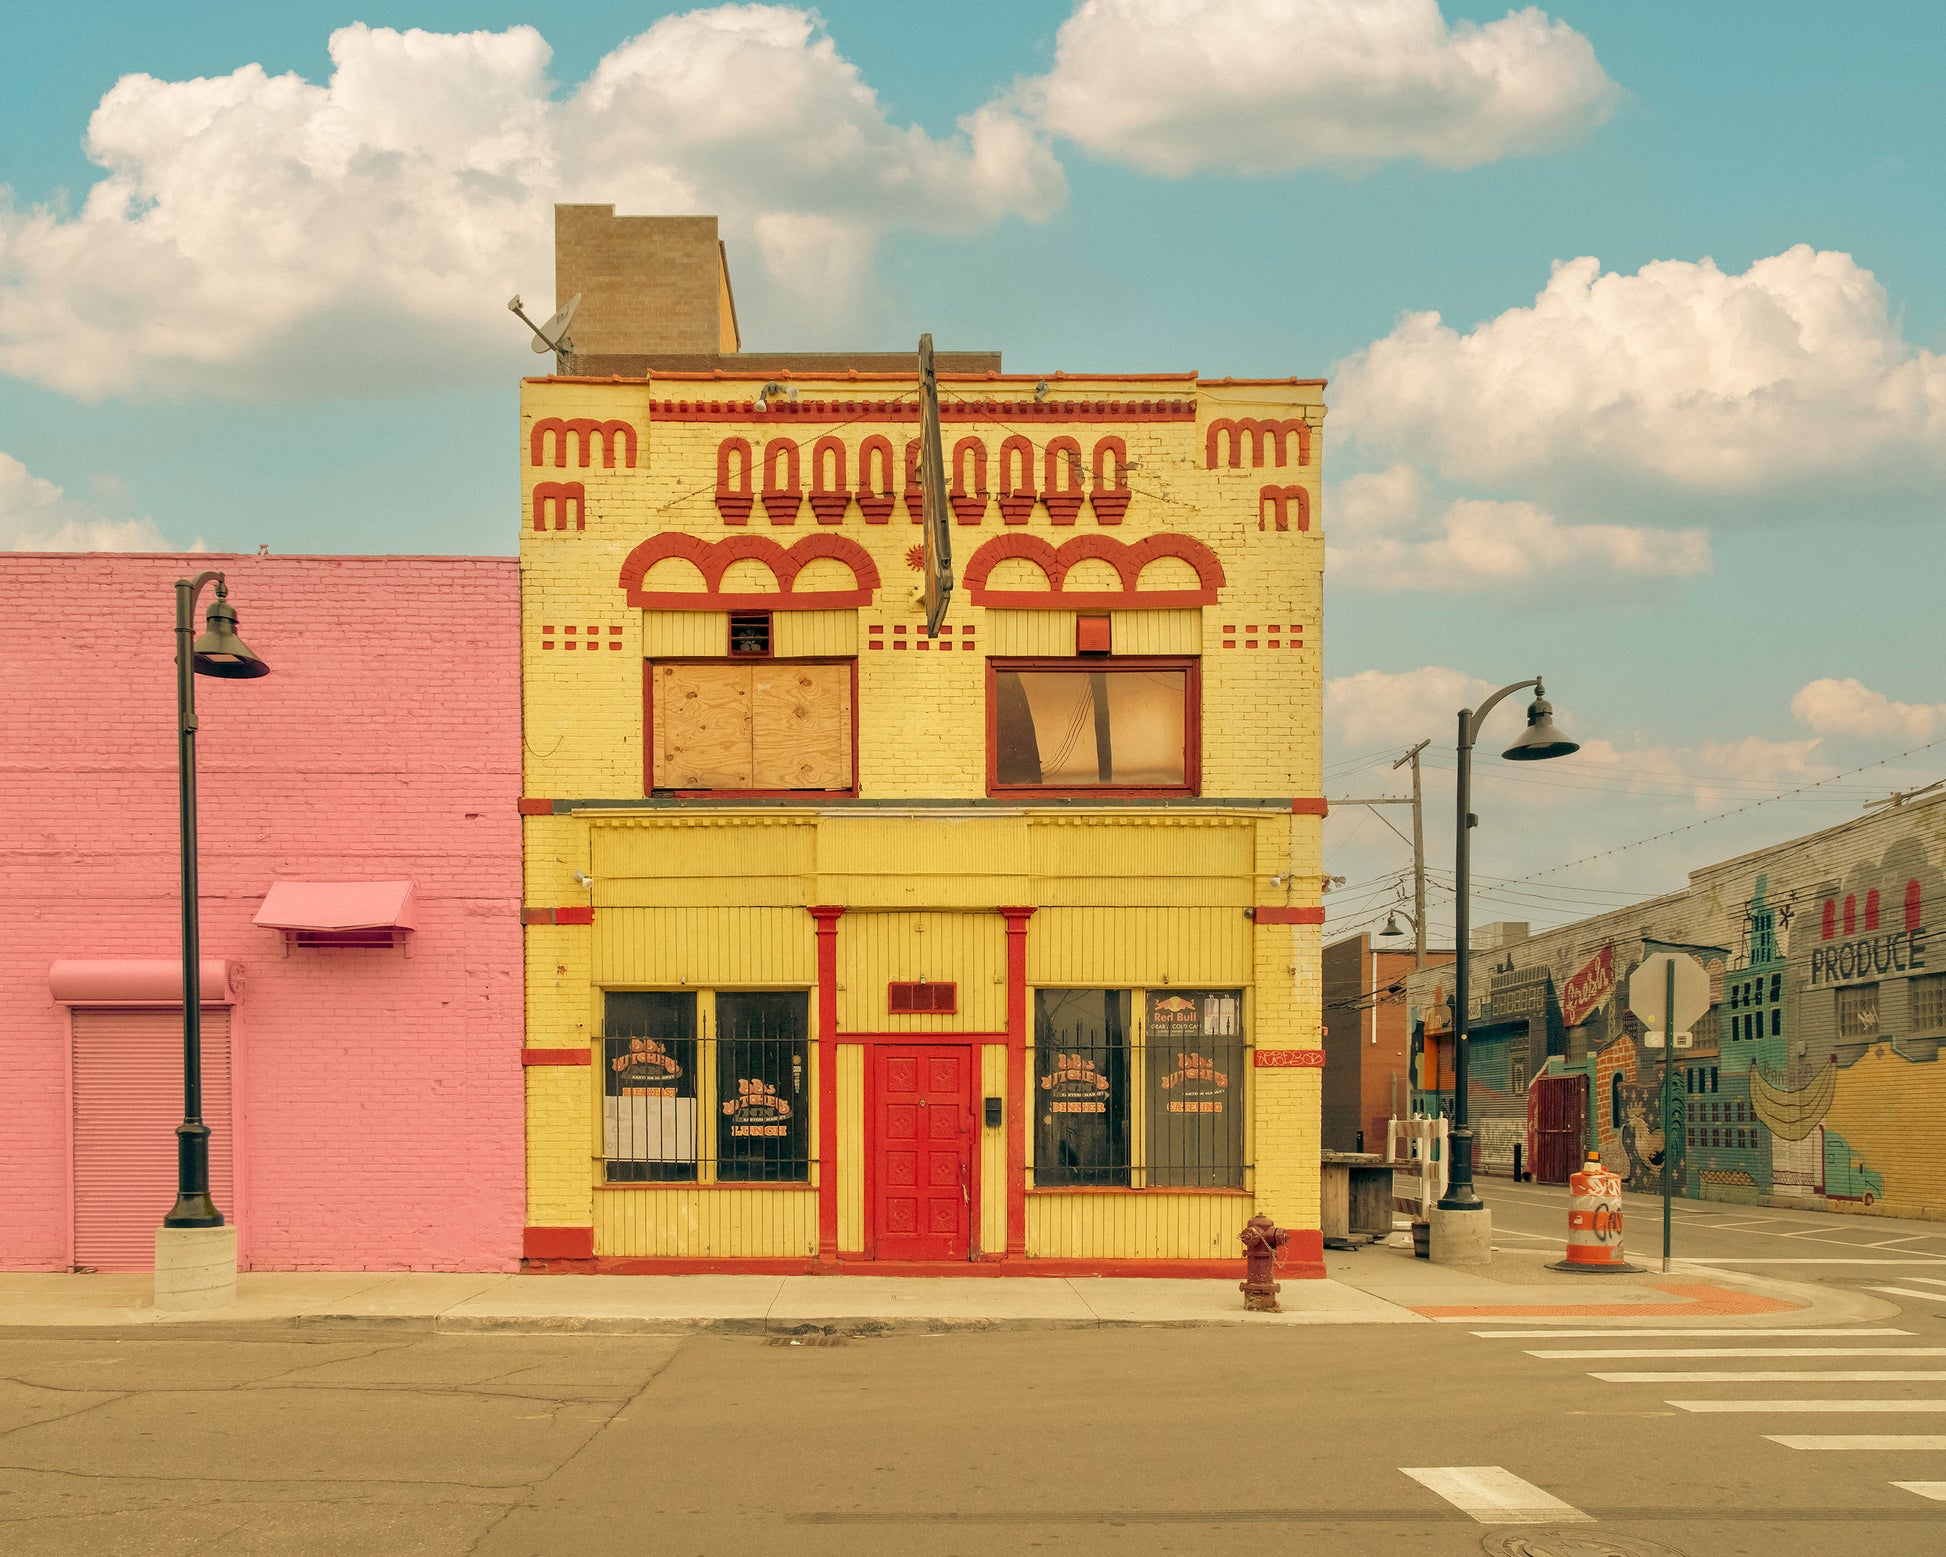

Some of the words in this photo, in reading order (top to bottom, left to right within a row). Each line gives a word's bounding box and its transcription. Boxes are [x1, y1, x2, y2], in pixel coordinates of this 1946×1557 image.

[1811, 927, 1926, 984] PRODUCE
[1154, 1012, 1173, 1021] Red
[1177, 1012, 1197, 1021] Bull
[732, 1126, 787, 1136] LUNCH
